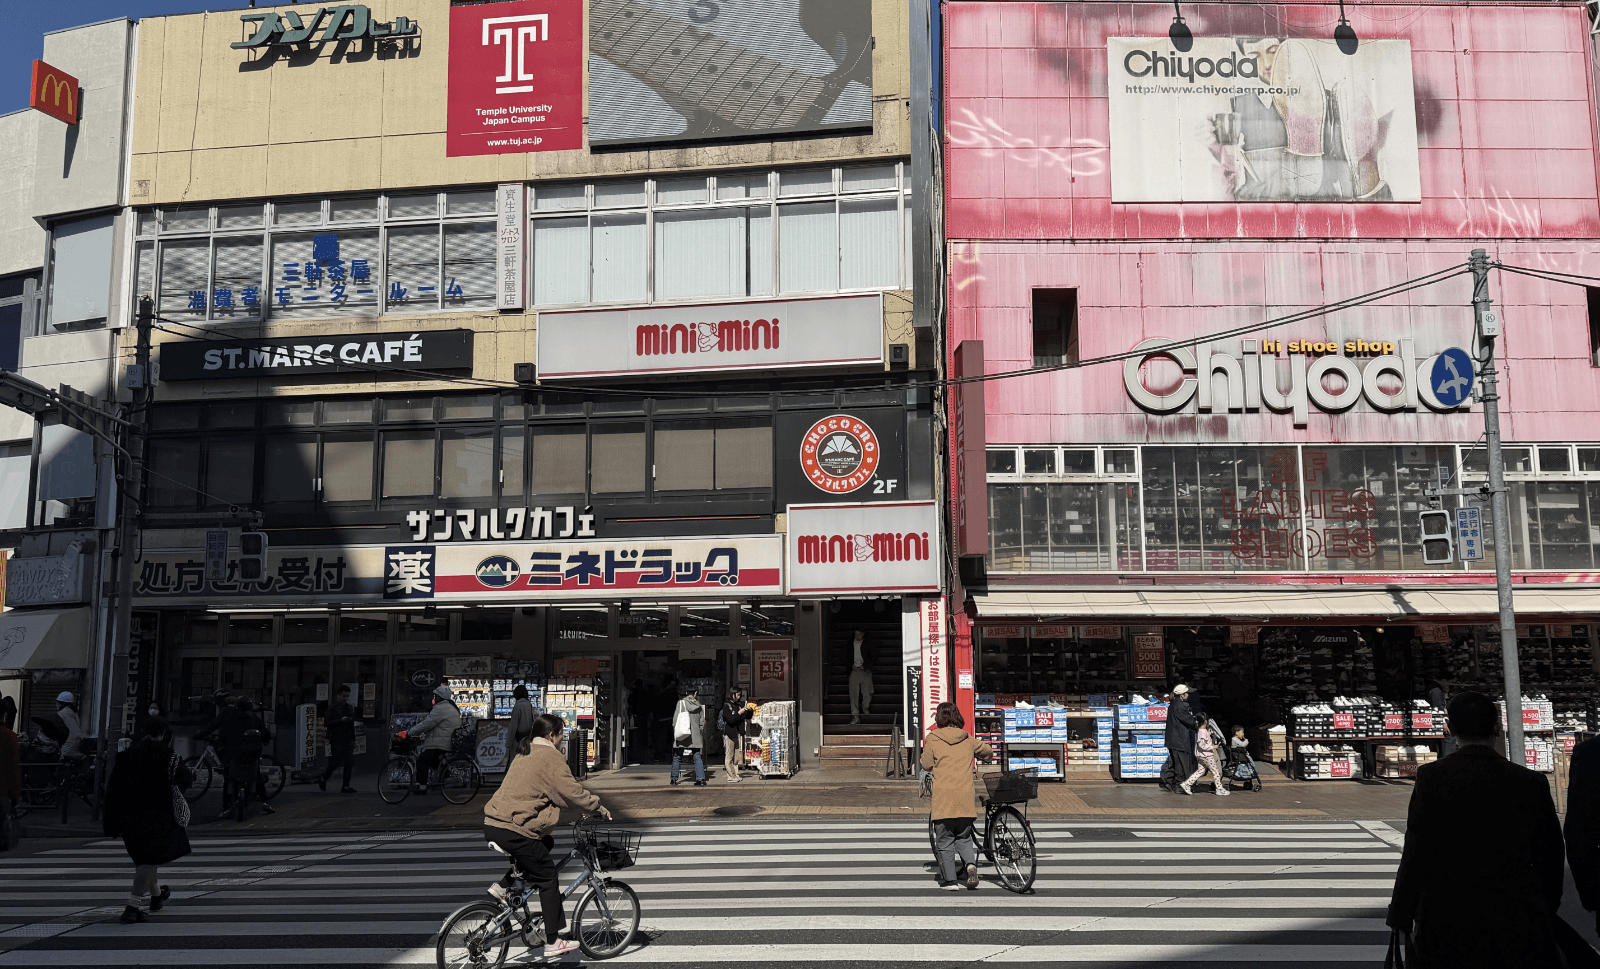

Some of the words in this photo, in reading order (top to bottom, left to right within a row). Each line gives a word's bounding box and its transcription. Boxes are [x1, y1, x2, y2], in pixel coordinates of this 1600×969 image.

[1124, 50, 1259, 83] Chiyoda
[476, 107, 507, 116] Temple
[509, 104, 553, 114] University
[482, 117, 509, 126] Japan
[511, 114, 546, 124] Campus
[487, 136, 543, 147] www.tuj.ac.jp
[504, 189, 516, 227] 資生堂
[281, 259, 369, 282] 三軒茶屋
[504, 245, 516, 305] 三軒茶屋店
[187, 278, 464, 309] 消費者モニタールーム
[203, 342, 334, 370] ST.MARC
[339, 333, 423, 364] CAFÉ
[636, 321, 697, 357] mini
[718, 317, 780, 352] mini
[1263, 340, 1281, 353] hi
[1288, 340, 1339, 353] shoe
[1345, 339, 1396, 355] shop
[804, 419, 875, 454] CHOCOCRO
[1271, 452, 1328, 482] 2F
[873, 479, 898, 494] 2F
[1222, 489, 1377, 520] LADIES
[406, 505, 596, 541] サンマルクカフェ
[1459, 511, 1469, 538] 自転車
[1469, 510, 1479, 537] 歩行者
[797, 534, 854, 564] mini
[872, 531, 929, 563] mini
[1230, 528, 1378, 558] SHOES
[1466, 539, 1476, 558] 専用
[9, 568, 56, 586] CANDY
[387, 550, 434, 594] 薬
[528, 548, 739, 586] ミネドラッグ
[16, 585, 43, 600] BOX
[1313, 635, 1347, 643] MIZUNO
[306, 707, 315, 756] 処方せん受付
